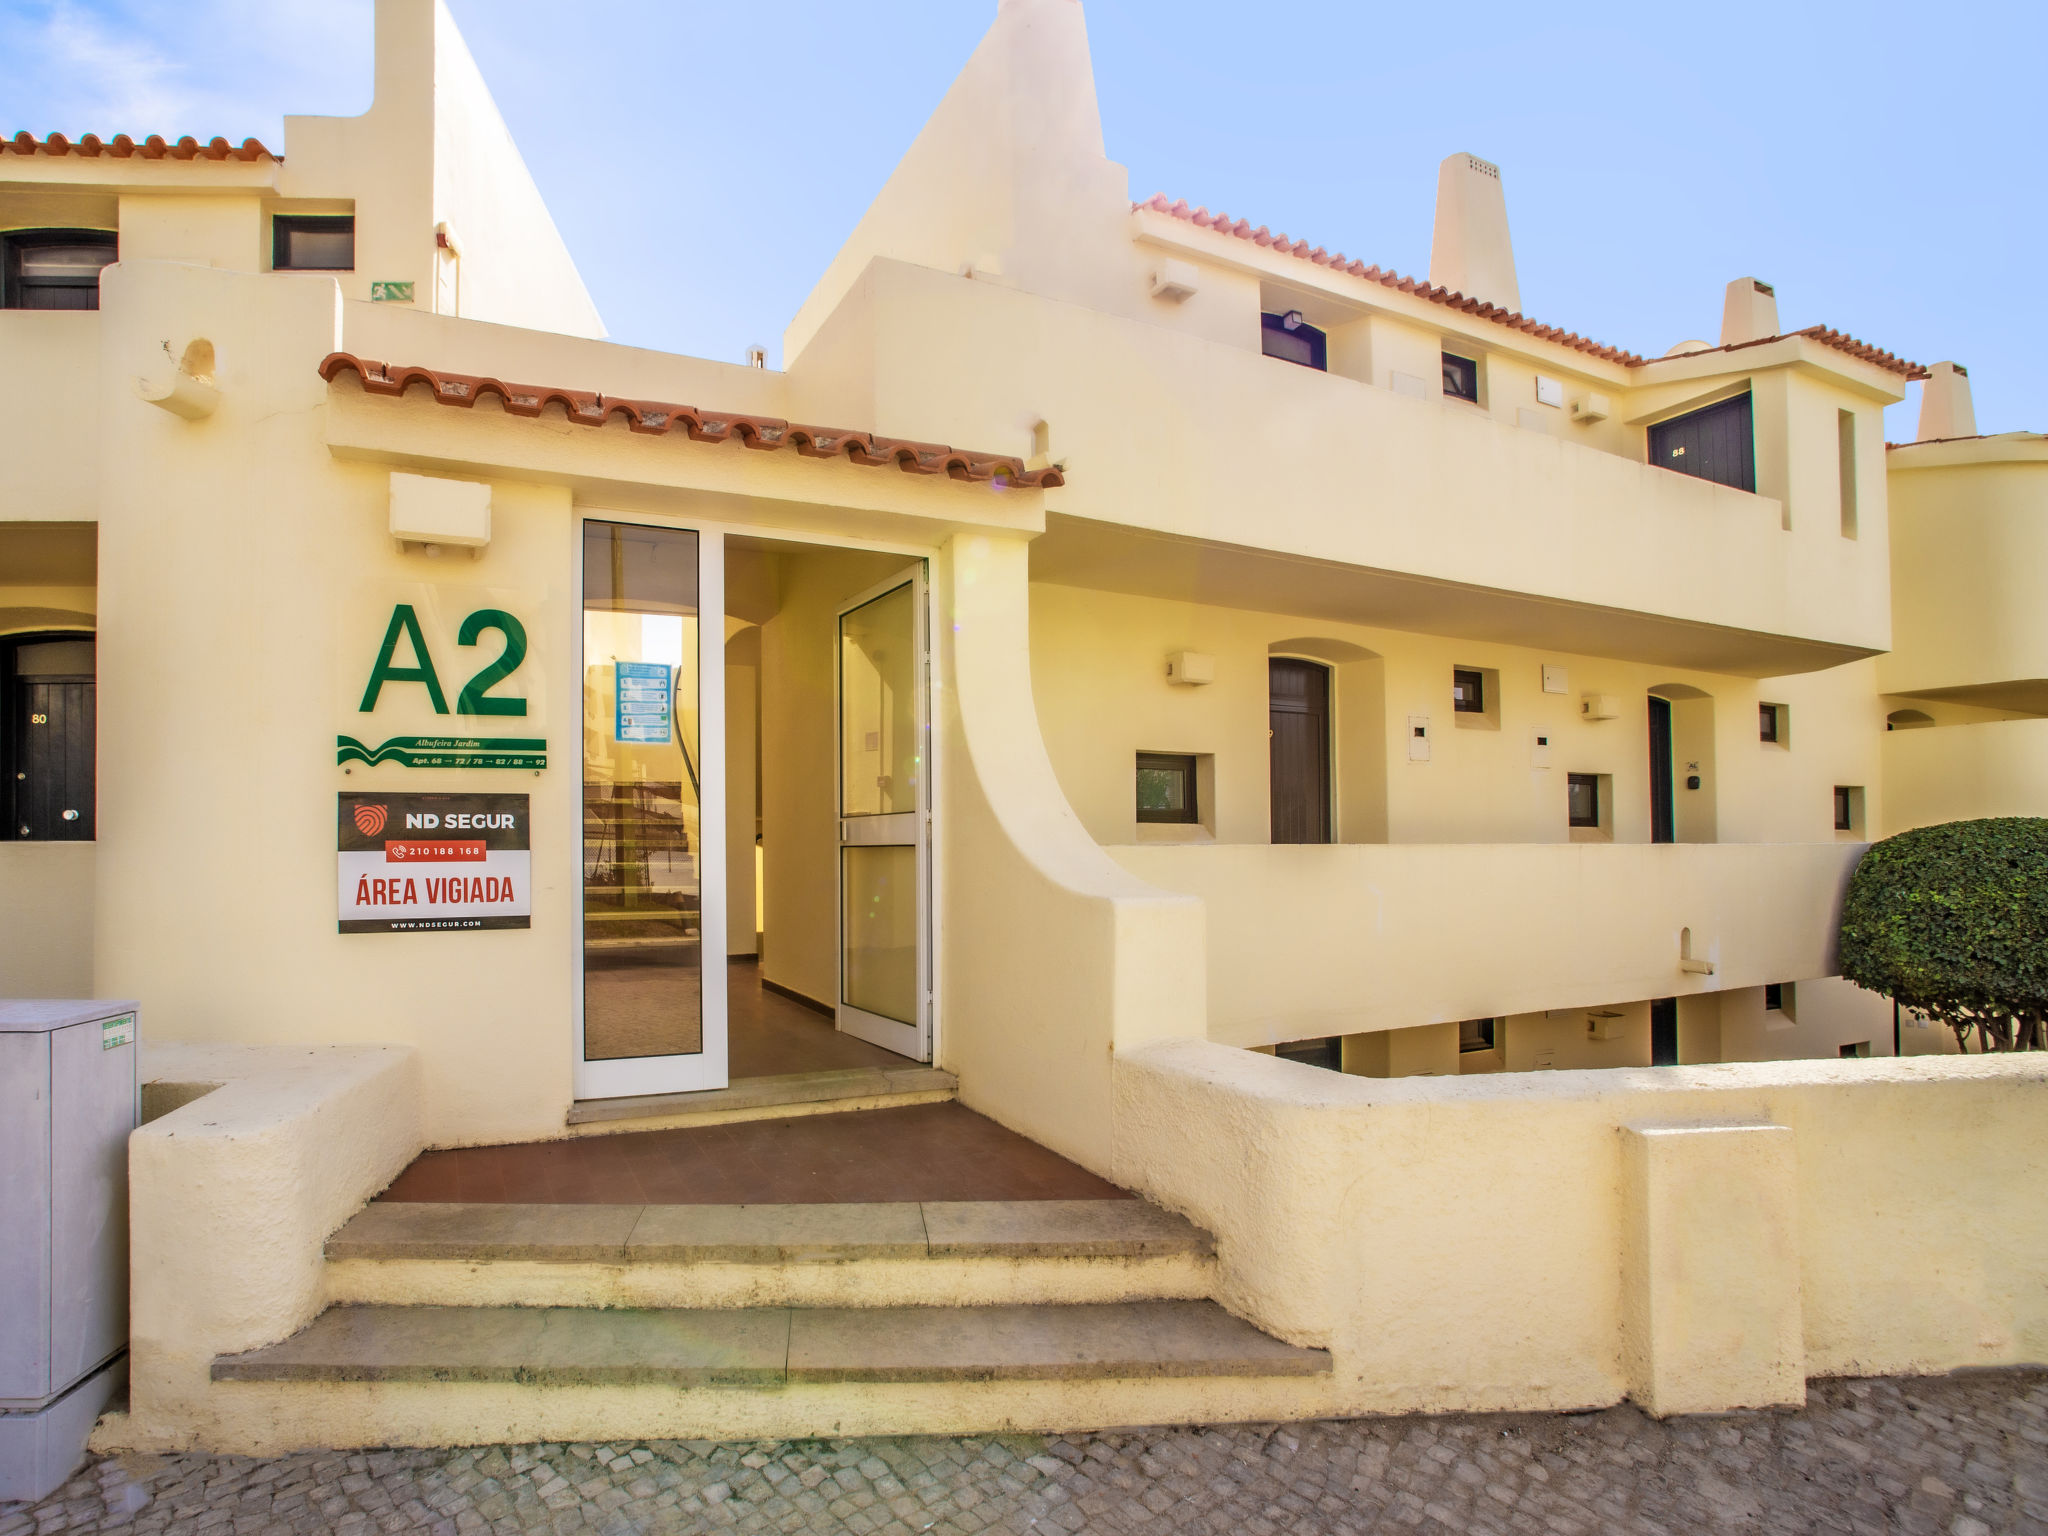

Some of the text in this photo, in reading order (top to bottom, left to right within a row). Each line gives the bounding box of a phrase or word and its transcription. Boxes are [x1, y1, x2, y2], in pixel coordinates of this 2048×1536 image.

[1672, 447, 1685, 457] 88
[359, 604, 528, 717] A2
[31, 714, 47, 724] 80
[415, 739, 481, 749] Albufeira Jardim
[412, 757, 430, 766] Apt.
[431, 757, 443, 765] 68
[455, 757, 465, 765] 72
[406, 813, 515, 829] ND SEGUR
[409, 847, 480, 856] 210 188 168
[355, 873, 515, 906] ÁREA VIGIADA
[391, 920, 482, 929] WWW.NDSEGUR.COM
